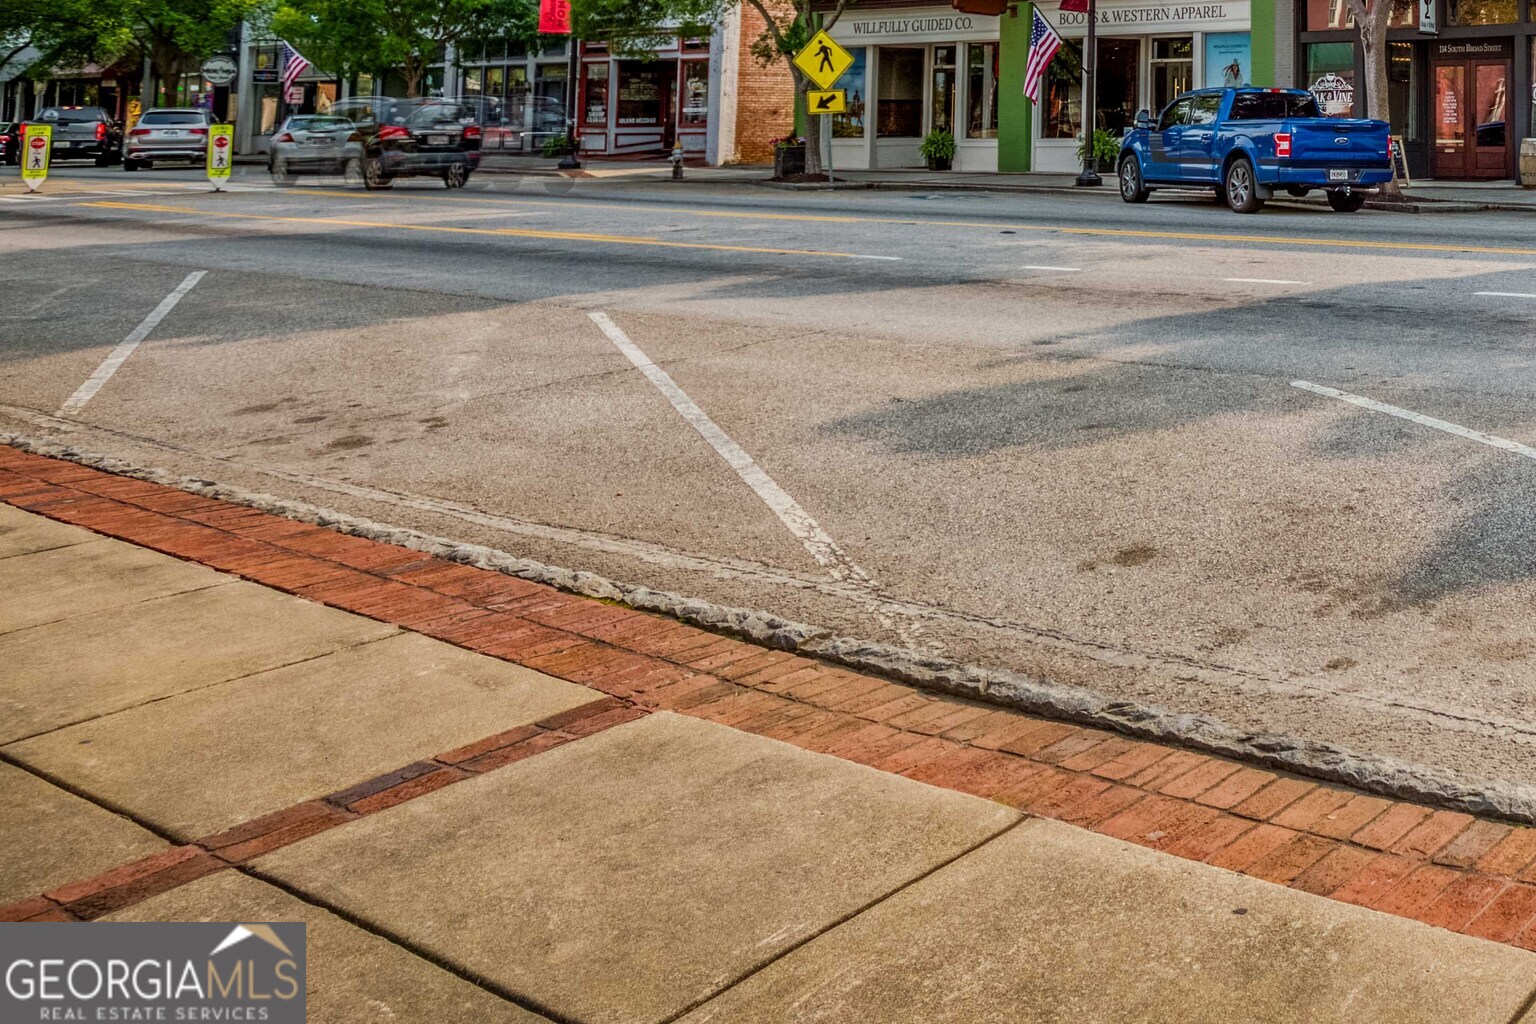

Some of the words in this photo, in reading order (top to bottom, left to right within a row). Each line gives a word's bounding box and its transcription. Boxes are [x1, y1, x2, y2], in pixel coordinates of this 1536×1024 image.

[1058, 10, 1099, 26] BOOS
[1101, 11, 1111, 23] &
[1112, 7, 1172, 23] WESTERN
[1173, 5, 1227, 21] APPAREL
[853, 20, 911, 35] WILLFULLY
[911, 17, 953, 32] GUIDED
[954, 16, 973, 31] CO.
[1332, 90, 1353, 103] VINE
